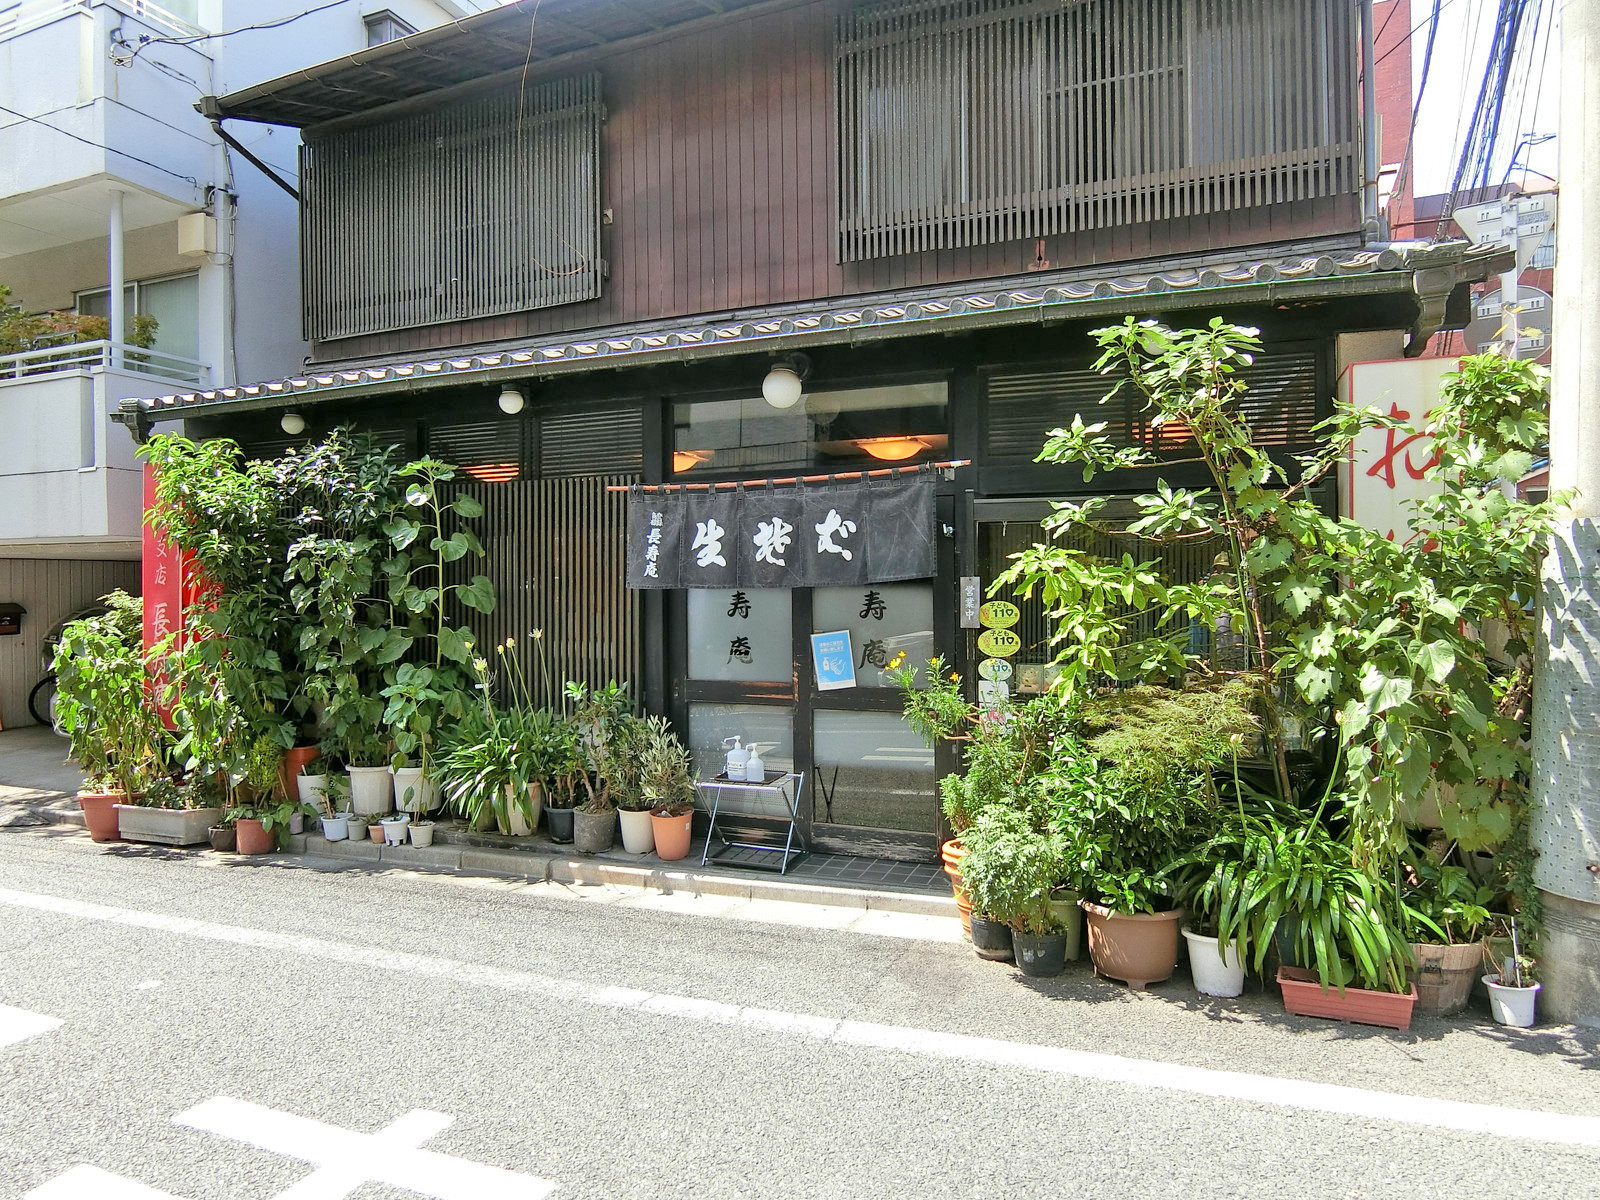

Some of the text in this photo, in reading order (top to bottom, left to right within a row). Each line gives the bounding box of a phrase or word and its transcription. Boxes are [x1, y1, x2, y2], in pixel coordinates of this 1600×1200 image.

[858, 590, 888, 670] 寿庵
[964, 585, 976, 622] 営業中
